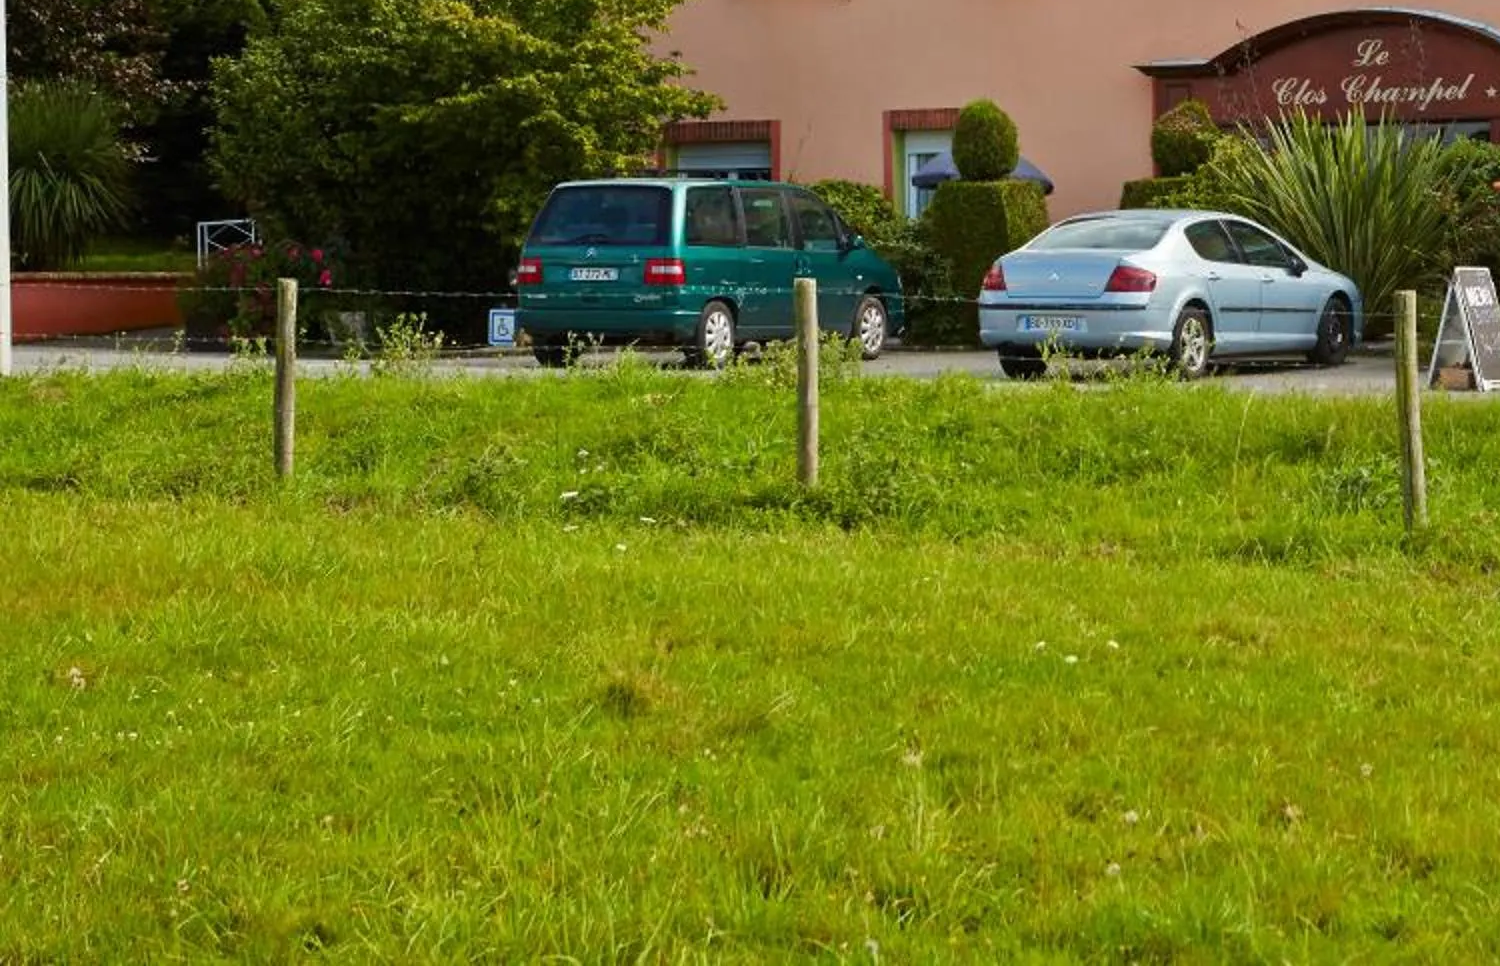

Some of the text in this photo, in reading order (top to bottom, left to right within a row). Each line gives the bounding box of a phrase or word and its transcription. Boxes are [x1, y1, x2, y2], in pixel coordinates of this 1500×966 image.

[1352, 38, 1390, 68] Le
[1271, 73, 1476, 112] Clos Champel
